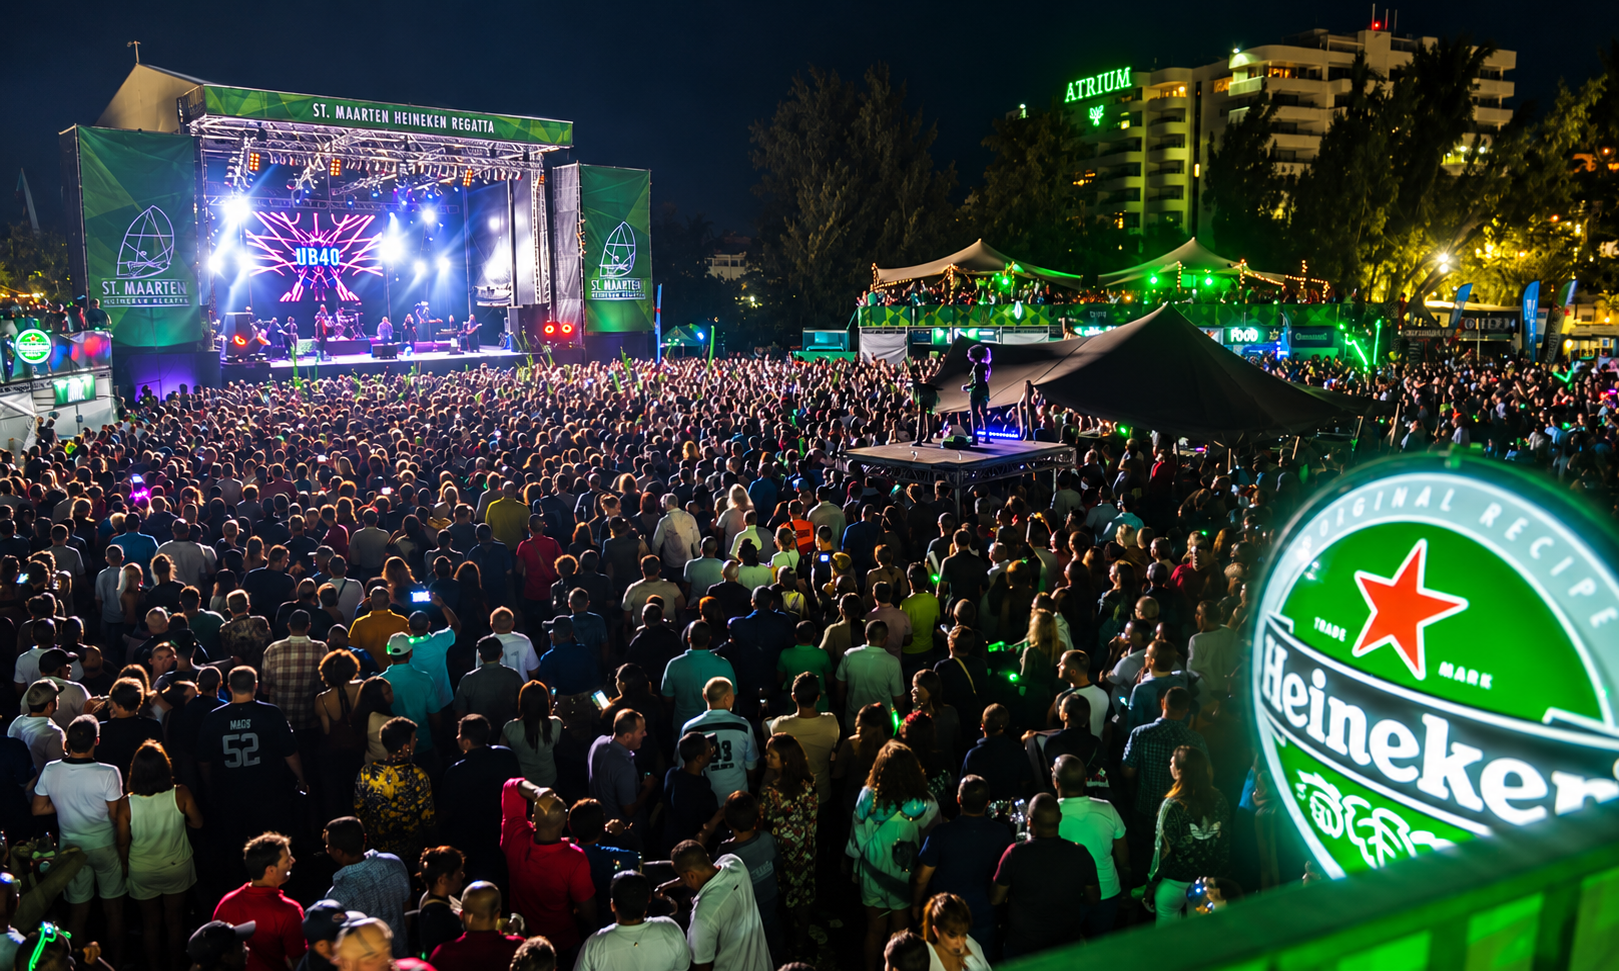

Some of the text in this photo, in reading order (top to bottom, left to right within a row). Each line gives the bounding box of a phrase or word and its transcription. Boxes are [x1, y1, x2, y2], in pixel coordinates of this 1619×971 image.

[1064, 66, 1132, 103] ATRIUM
[312, 102, 495, 134] ST. MAARTEN HEINEKEN REGATTA
[295, 247, 340, 266] UB40
[101, 281, 187, 295] ST. MAARTEN
[1230, 327, 1259, 343] FOOD
[1479, 502, 1619, 628] RECIPE
[1313, 616, 1493, 690] TRADE MARK
[222, 732, 261, 769] 52
